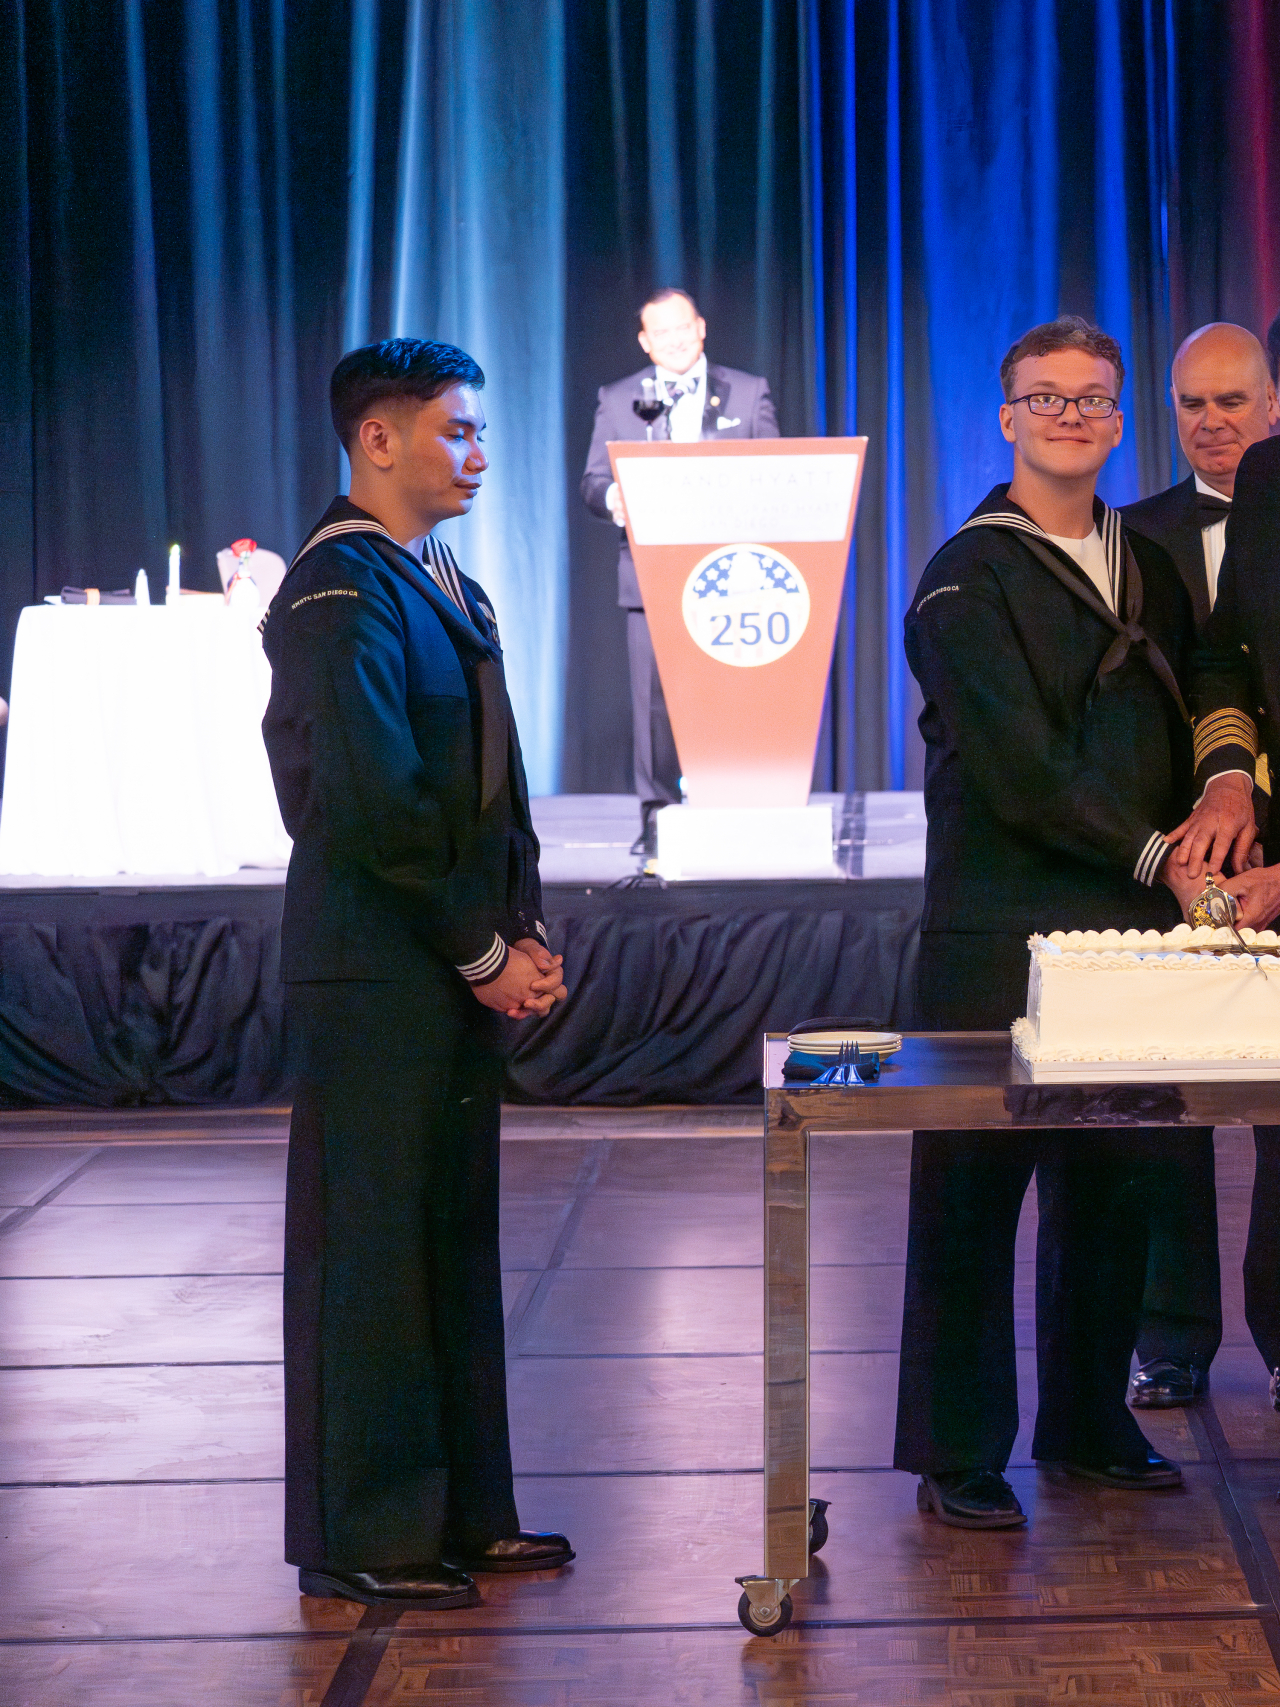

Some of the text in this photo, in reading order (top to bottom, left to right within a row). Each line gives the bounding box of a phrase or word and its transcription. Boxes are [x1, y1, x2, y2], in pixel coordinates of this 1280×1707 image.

[749, 470, 834, 487] HYATT
[313, 591, 326, 600] SAN
[709, 611, 791, 646] 250
